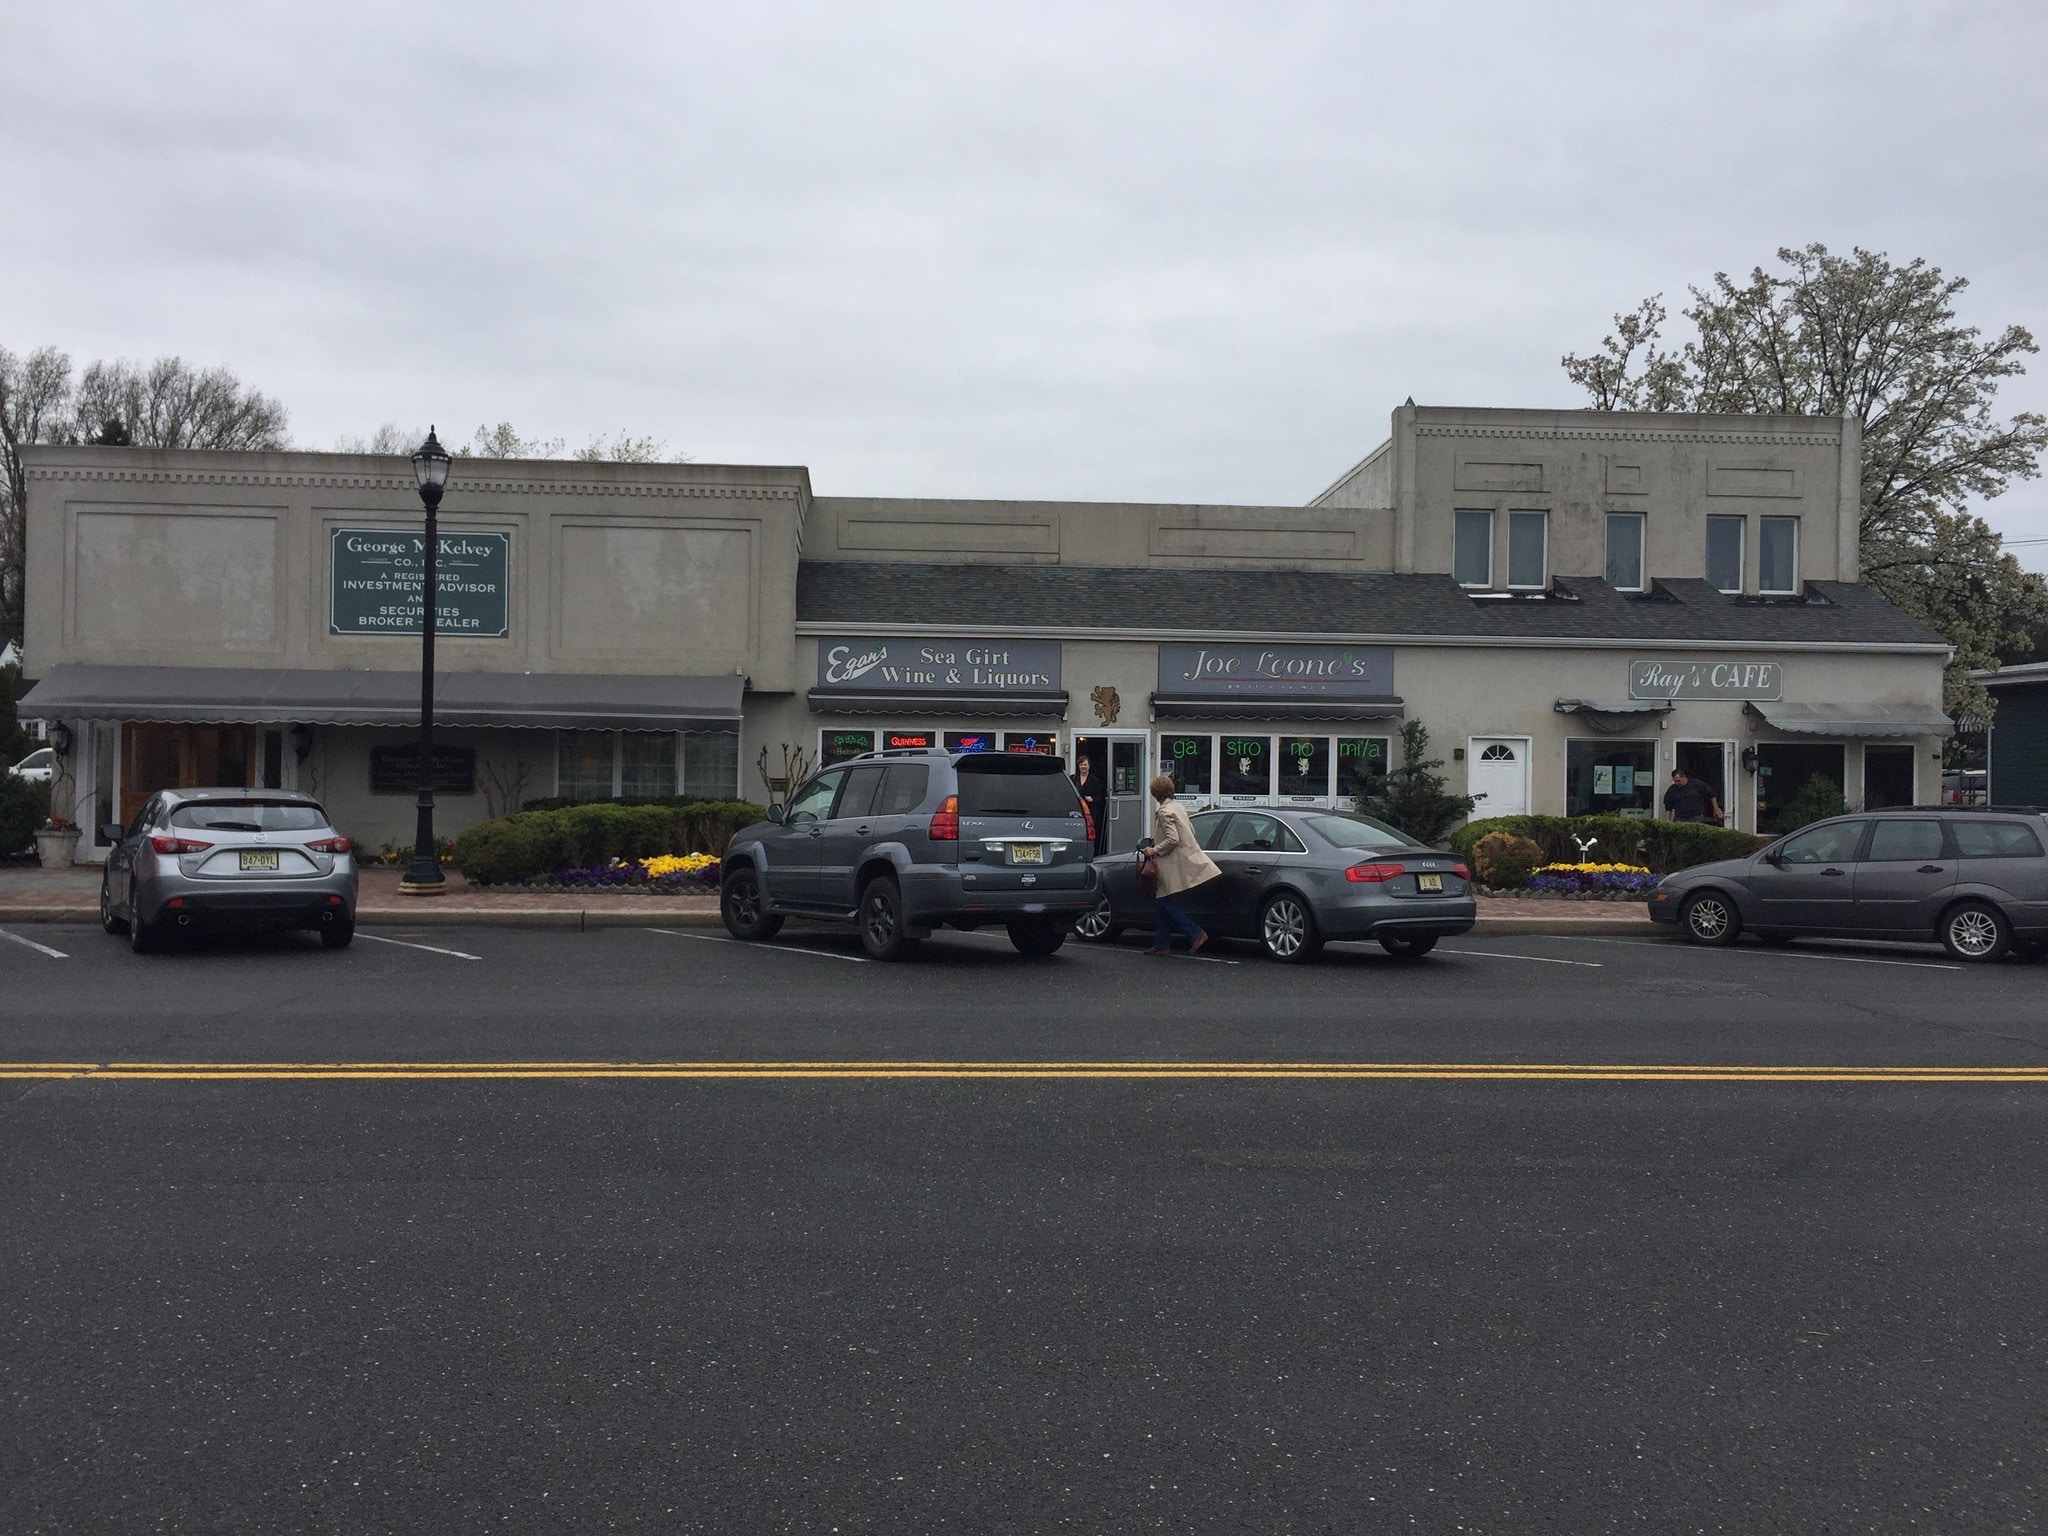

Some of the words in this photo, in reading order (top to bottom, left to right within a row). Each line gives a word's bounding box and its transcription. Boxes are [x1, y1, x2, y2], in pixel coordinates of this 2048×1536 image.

[347, 536, 406, 555] George
[413, 538, 494, 558] MKelvey
[421, 558, 447, 568] IC.
[380, 572, 388, 580] A
[394, 572, 460, 581] REGISRED
[343, 580, 426, 591] INVESTMEN
[438, 583, 496, 593] ADVISOR
[379, 606, 460, 617] SECURIES
[358, 616, 414, 626] BROKER
[436, 618, 480, 628] EALER
[920, 647, 956, 664] Sea
[965, 648, 1010, 665] Girt
[1182, 650, 1241, 681] Joe
[1253, 650, 1367, 679] Leone's
[881, 666, 936, 683] Wine
[945, 667, 962, 685] &
[973, 668, 1050, 689] Liquors
[1639, 663, 1702, 697] Ray's
[1711, 664, 1773, 688] CAFE
[891, 736, 927, 747] GUINNESS
[1173, 740, 1199, 759] ga
[1226, 740, 1261, 756] stro
[1290, 742, 1315, 757] no
